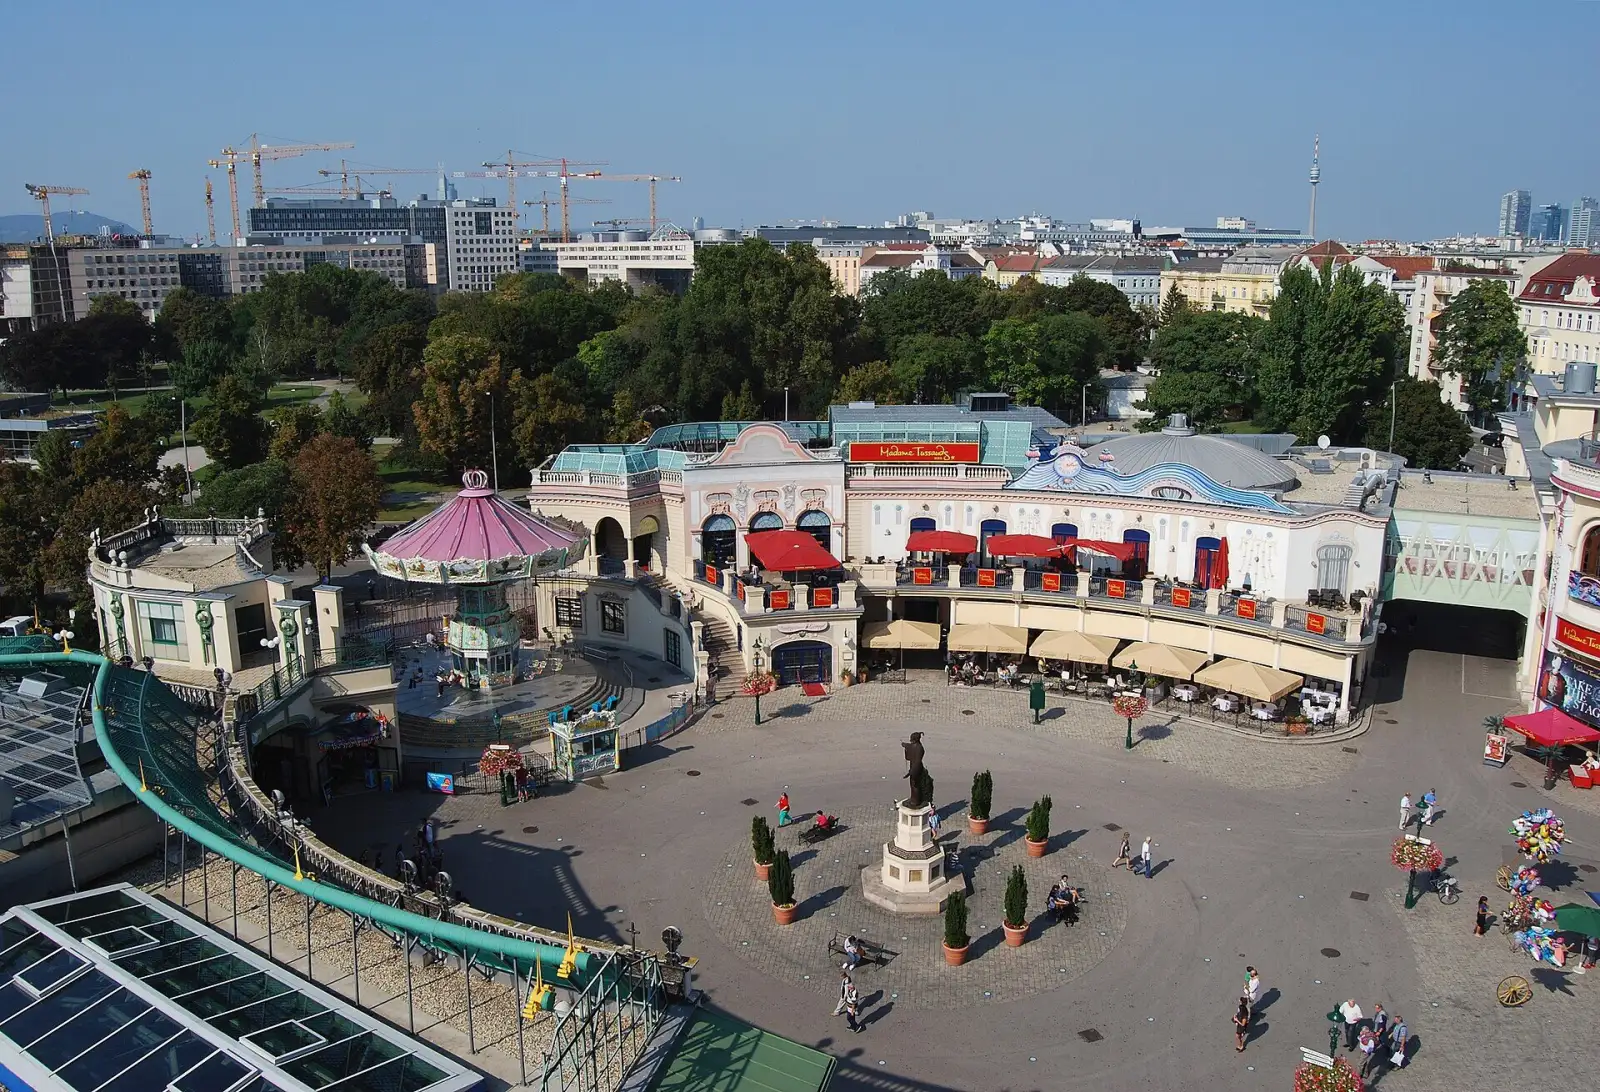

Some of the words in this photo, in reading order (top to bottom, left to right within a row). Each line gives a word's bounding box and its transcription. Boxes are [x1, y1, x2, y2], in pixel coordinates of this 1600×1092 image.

[880, 445, 915, 457] Madame
[912, 445, 950, 460] Tussauds
[1563, 626, 1588, 645] Madame
[1566, 675, 1593, 695] TAKE
[1567, 685, 1587, 703] THE
